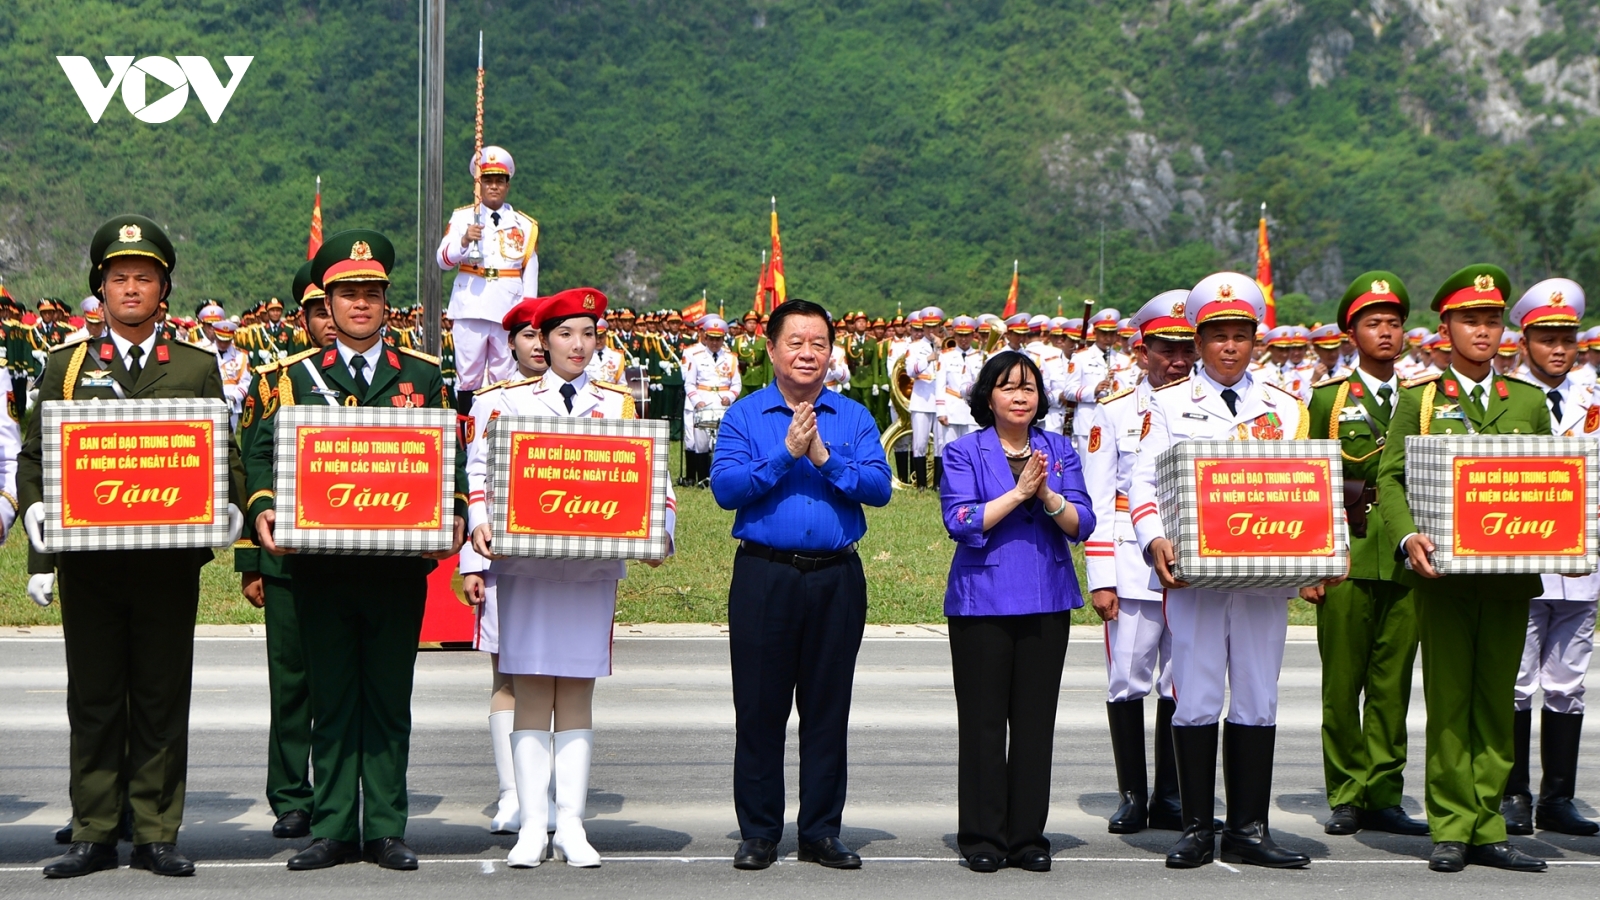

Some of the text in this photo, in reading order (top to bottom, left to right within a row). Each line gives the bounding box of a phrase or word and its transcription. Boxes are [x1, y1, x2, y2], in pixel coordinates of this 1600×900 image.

[80, 433, 195, 451] BAN CHỈ ĐẠO TRUNG ƯƠNG
[314, 437, 425, 456] BAN CHỈ ĐẠO TRUNG ƯƠNG
[76, 452, 200, 472] KỶ NIỆM CÁC NGÀY LỄ LỚN
[528, 445, 636, 464] BAN CHỈ ĐẠO TRUNG ƯƠNG
[310, 458, 429, 475] KỶ NIỆM CÁC NGÀY LỄ LỚN
[524, 464, 638, 483] KỶ NIỆM CÁC NGÀY LỄ LỚN
[1212, 469, 1315, 486] BAN CHỈ ĐẠO TRUNG ƯƠNG
[1469, 468, 1570, 486] BAN CHỈ ĐẠO TRUNG ƯƠNG
[94, 480, 182, 508] Tặng
[327, 483, 411, 512] Tặng
[1210, 488, 1319, 504] KỶ NIỆM CÁC NGÀY LỄ LỚN
[1466, 487, 1573, 504] KỶ NIỆM CÁC NGÀY LỄ LỚN
[539, 490, 620, 520] Tặng
[1227, 512, 1305, 539] Tặng
[1481, 512, 1557, 539] Tặng
